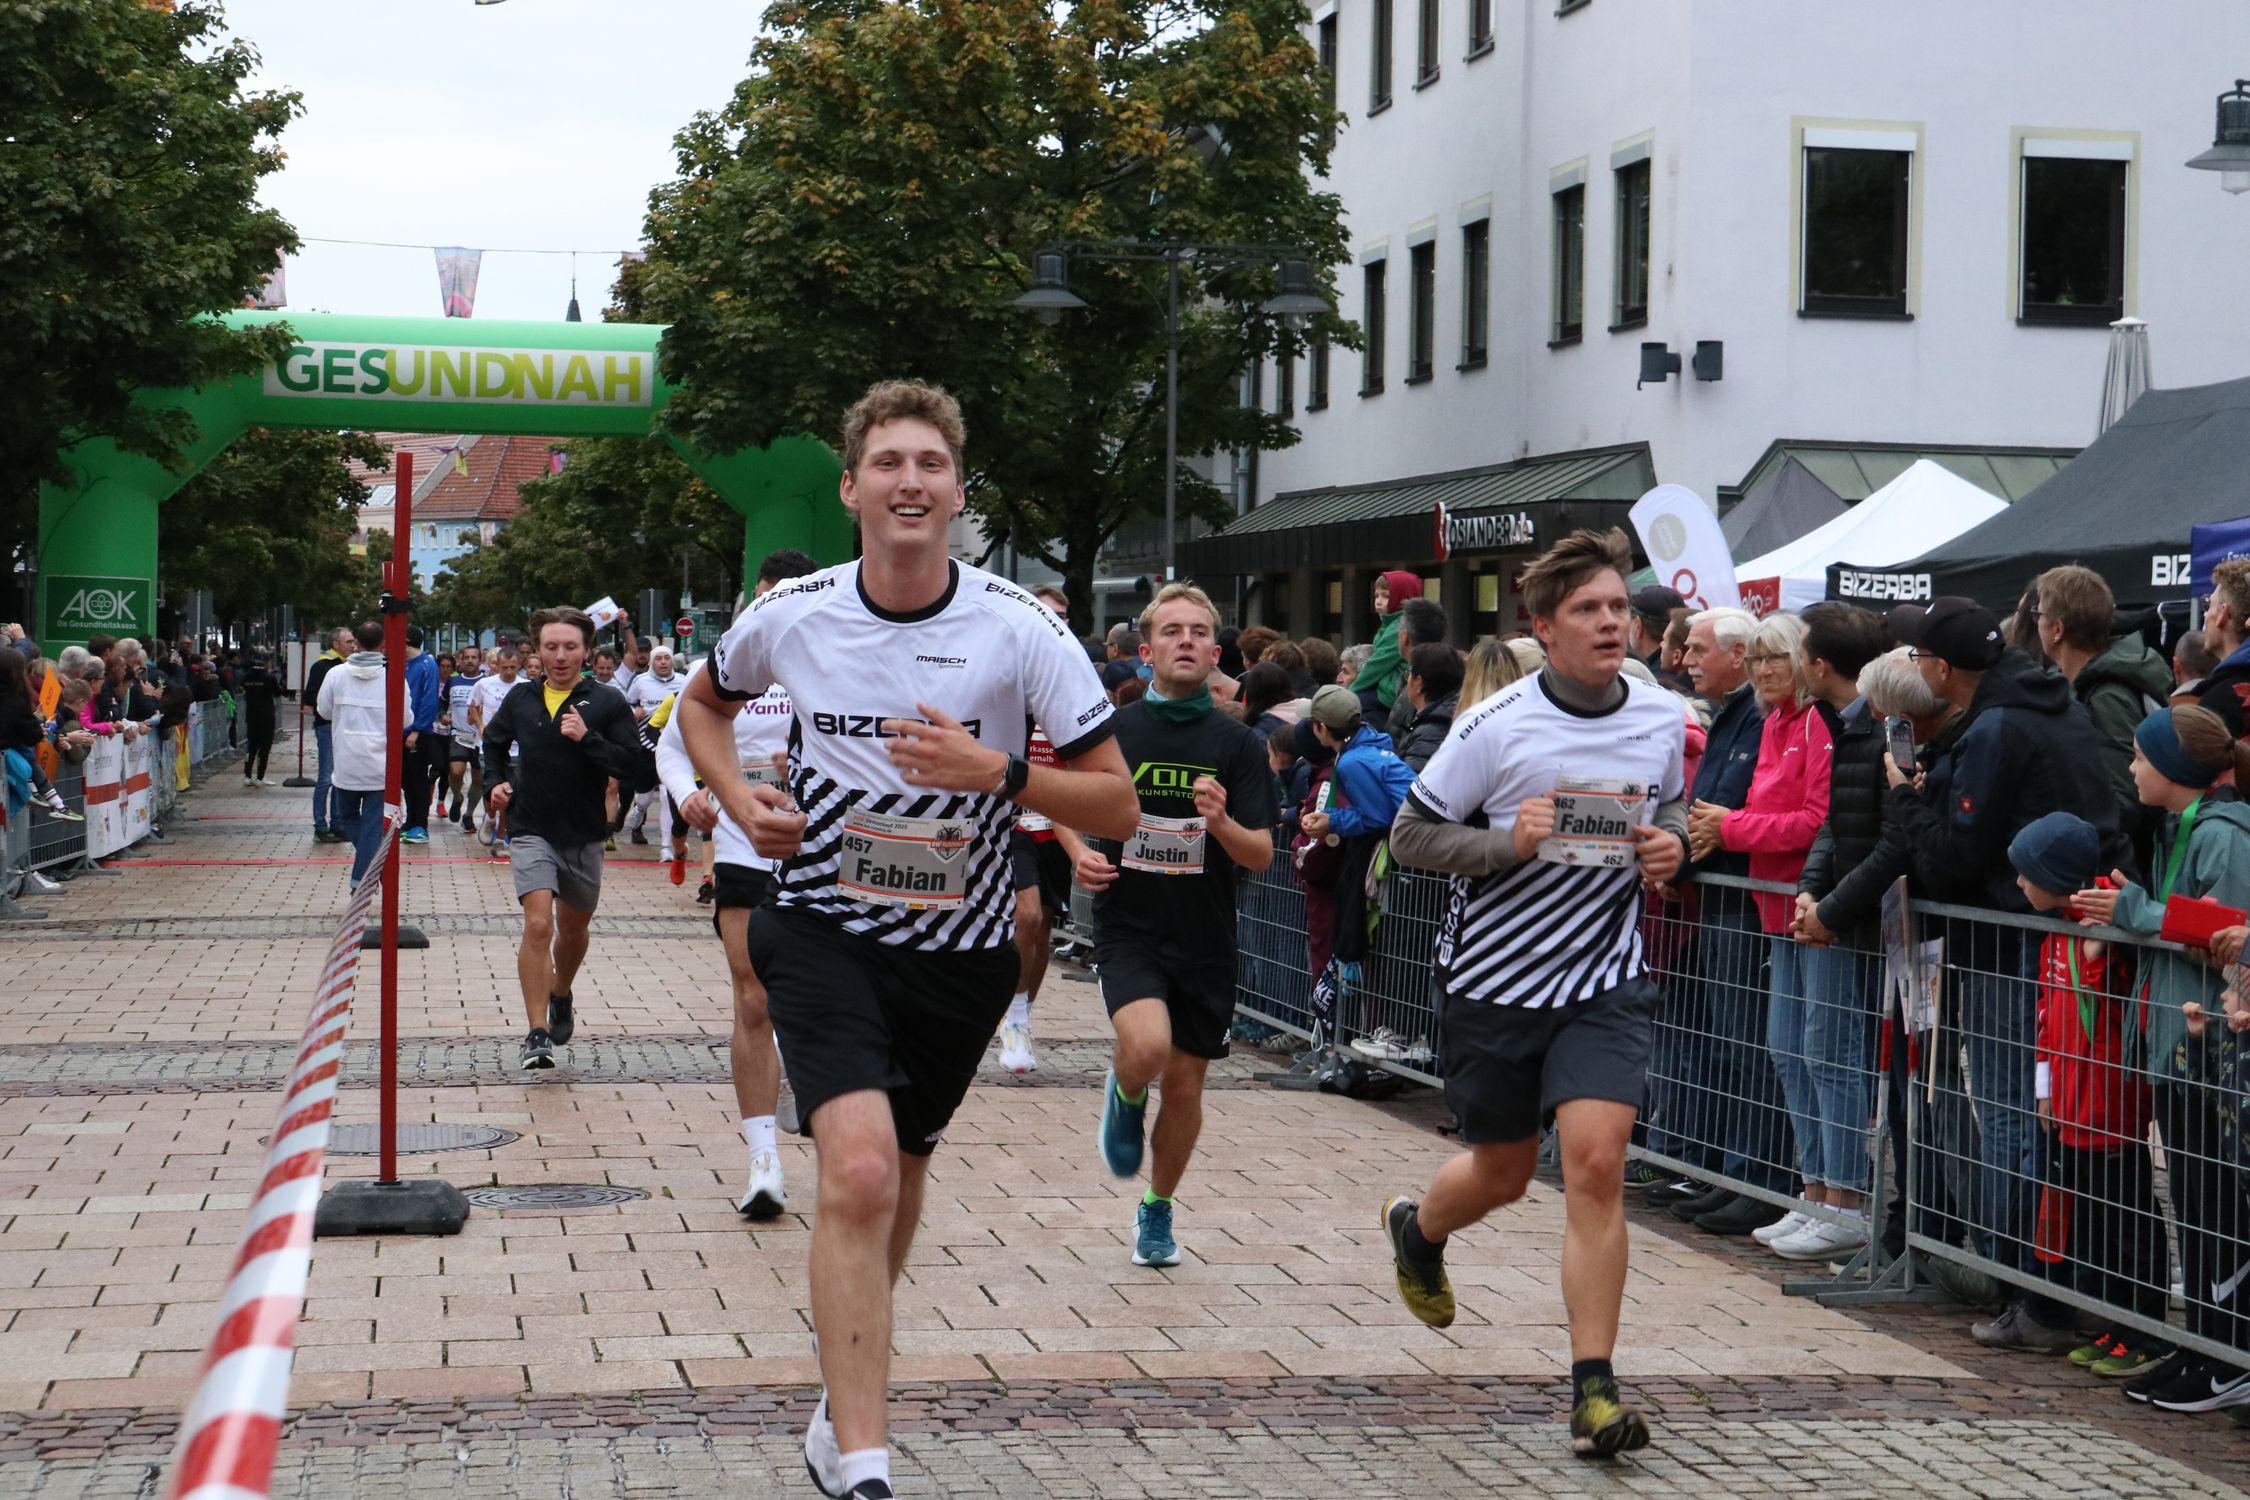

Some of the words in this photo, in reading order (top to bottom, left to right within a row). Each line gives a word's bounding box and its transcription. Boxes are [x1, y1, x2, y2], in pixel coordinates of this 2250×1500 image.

[277, 345, 642, 402] GESUNDNAH
[2151, 554, 2191, 586] BIZ
[754, 577, 836, 612] BIZERBA
[1840, 570, 1931, 600] BIZERBA
[59, 589, 137, 620] AOK
[916, 655, 967, 664] MAISCH
[813, 712, 981, 739] BIZEA
[1560, 813, 1627, 836] Fabian
[844, 836, 873, 854] 457
[1135, 843, 1188, 864] Justin
[1603, 854, 1624, 866] 462
[855, 858, 947, 892] Fabian
